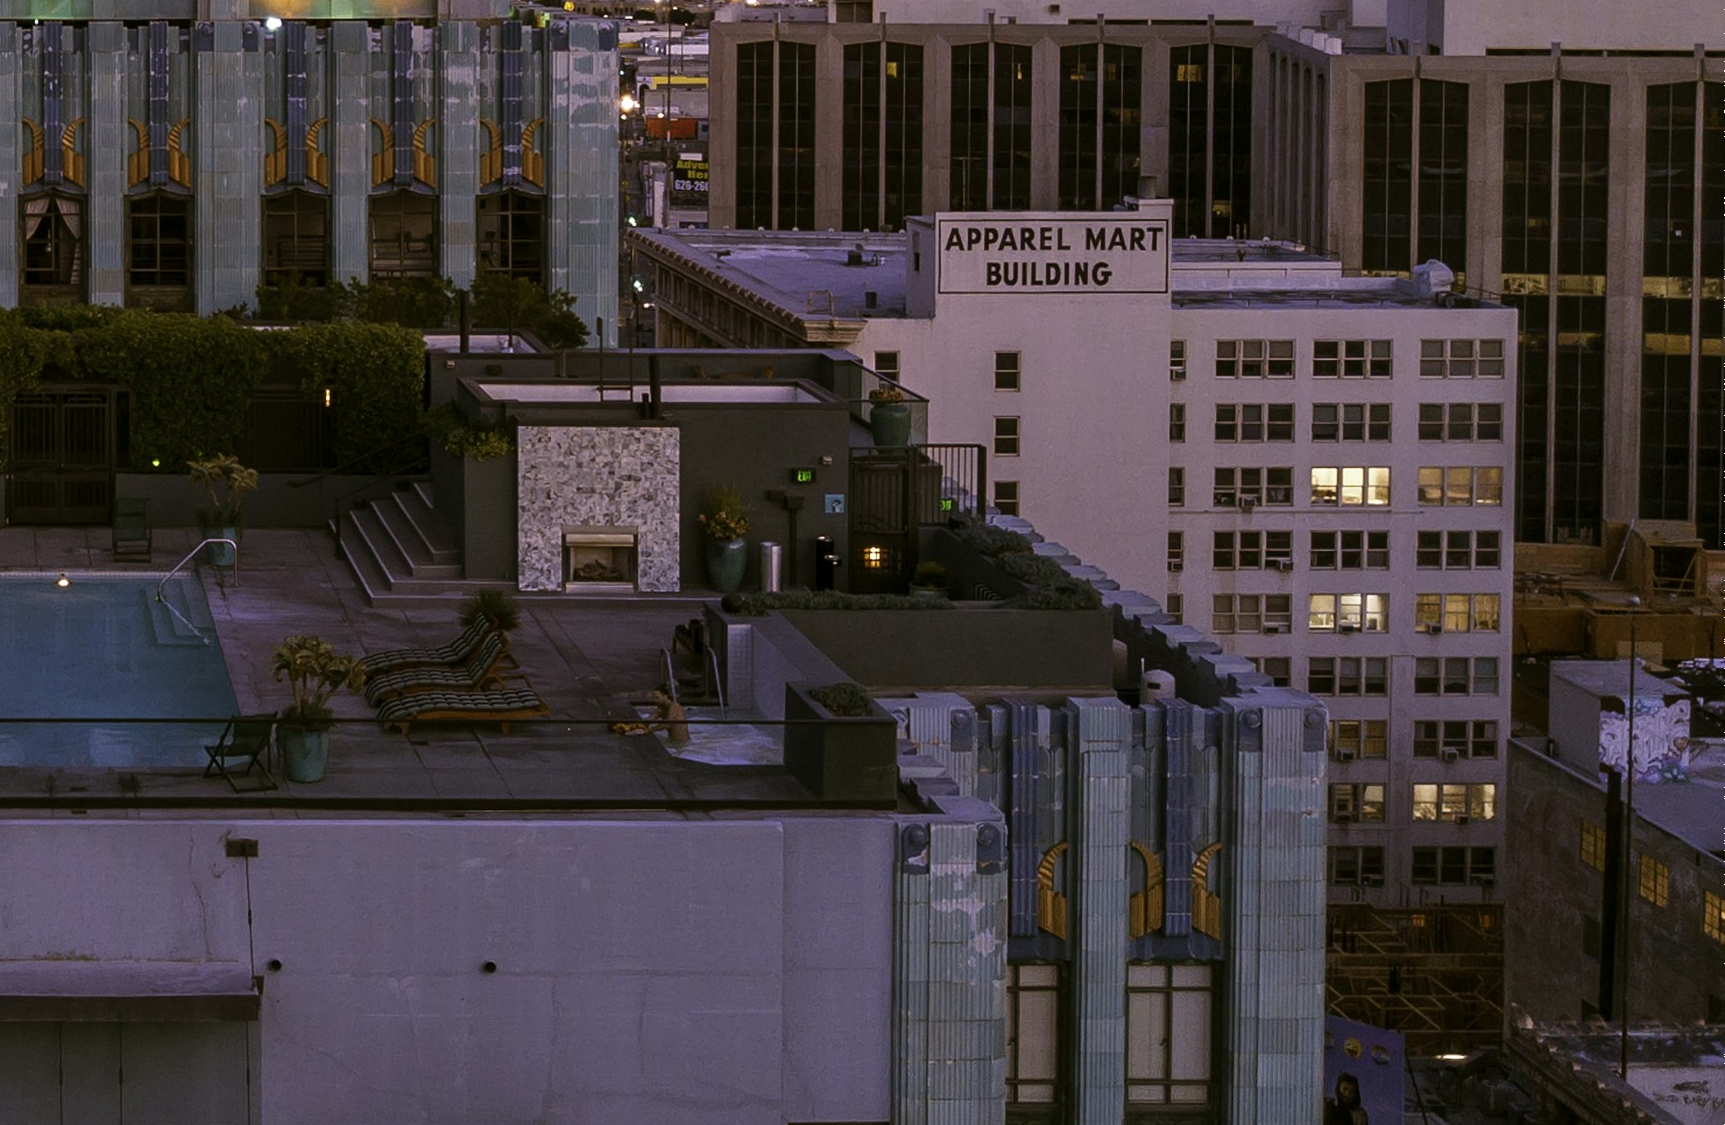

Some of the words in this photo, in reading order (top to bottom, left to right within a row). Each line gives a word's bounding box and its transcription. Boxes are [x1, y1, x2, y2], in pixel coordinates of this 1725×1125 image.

[945, 227, 1071, 251] APPAREL
[1085, 227, 1164, 251] MART
[986, 262, 1113, 286] BUILDING
